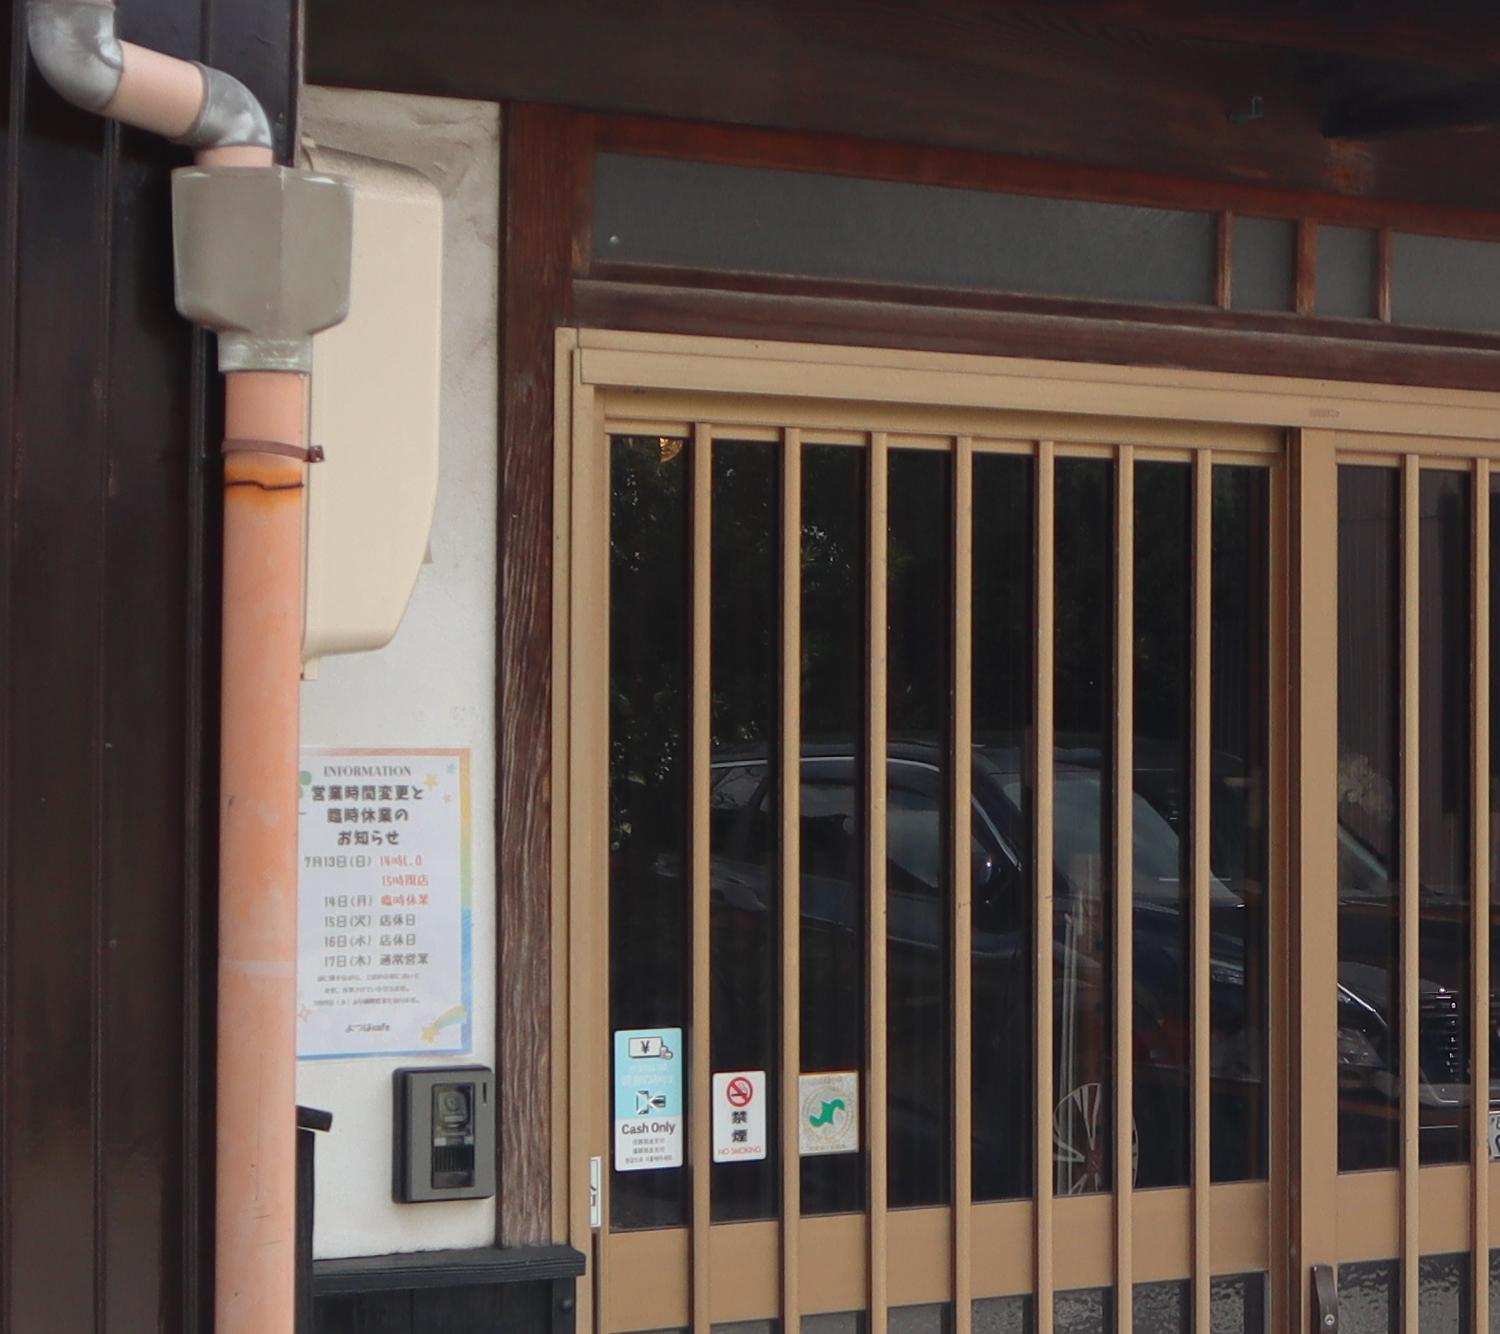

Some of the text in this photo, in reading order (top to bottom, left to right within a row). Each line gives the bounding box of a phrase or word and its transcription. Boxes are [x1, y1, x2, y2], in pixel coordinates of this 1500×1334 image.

[323, 765, 411, 777] INFORMATION
[311, 785, 424, 802] 営業時間変更と
[327, 807, 409, 823] 臨時休業の
[337, 830, 400, 846] お知らせ
[379, 913, 416, 926] 店休日
[379, 933, 416, 946] 店休日
[379, 953, 429, 966] 通常営業
[621, 1121, 676, 1135] Cash Only
[731, 1110, 748, 1143] 禁煙
[718, 1145, 762, 1156] NO SMOKING
